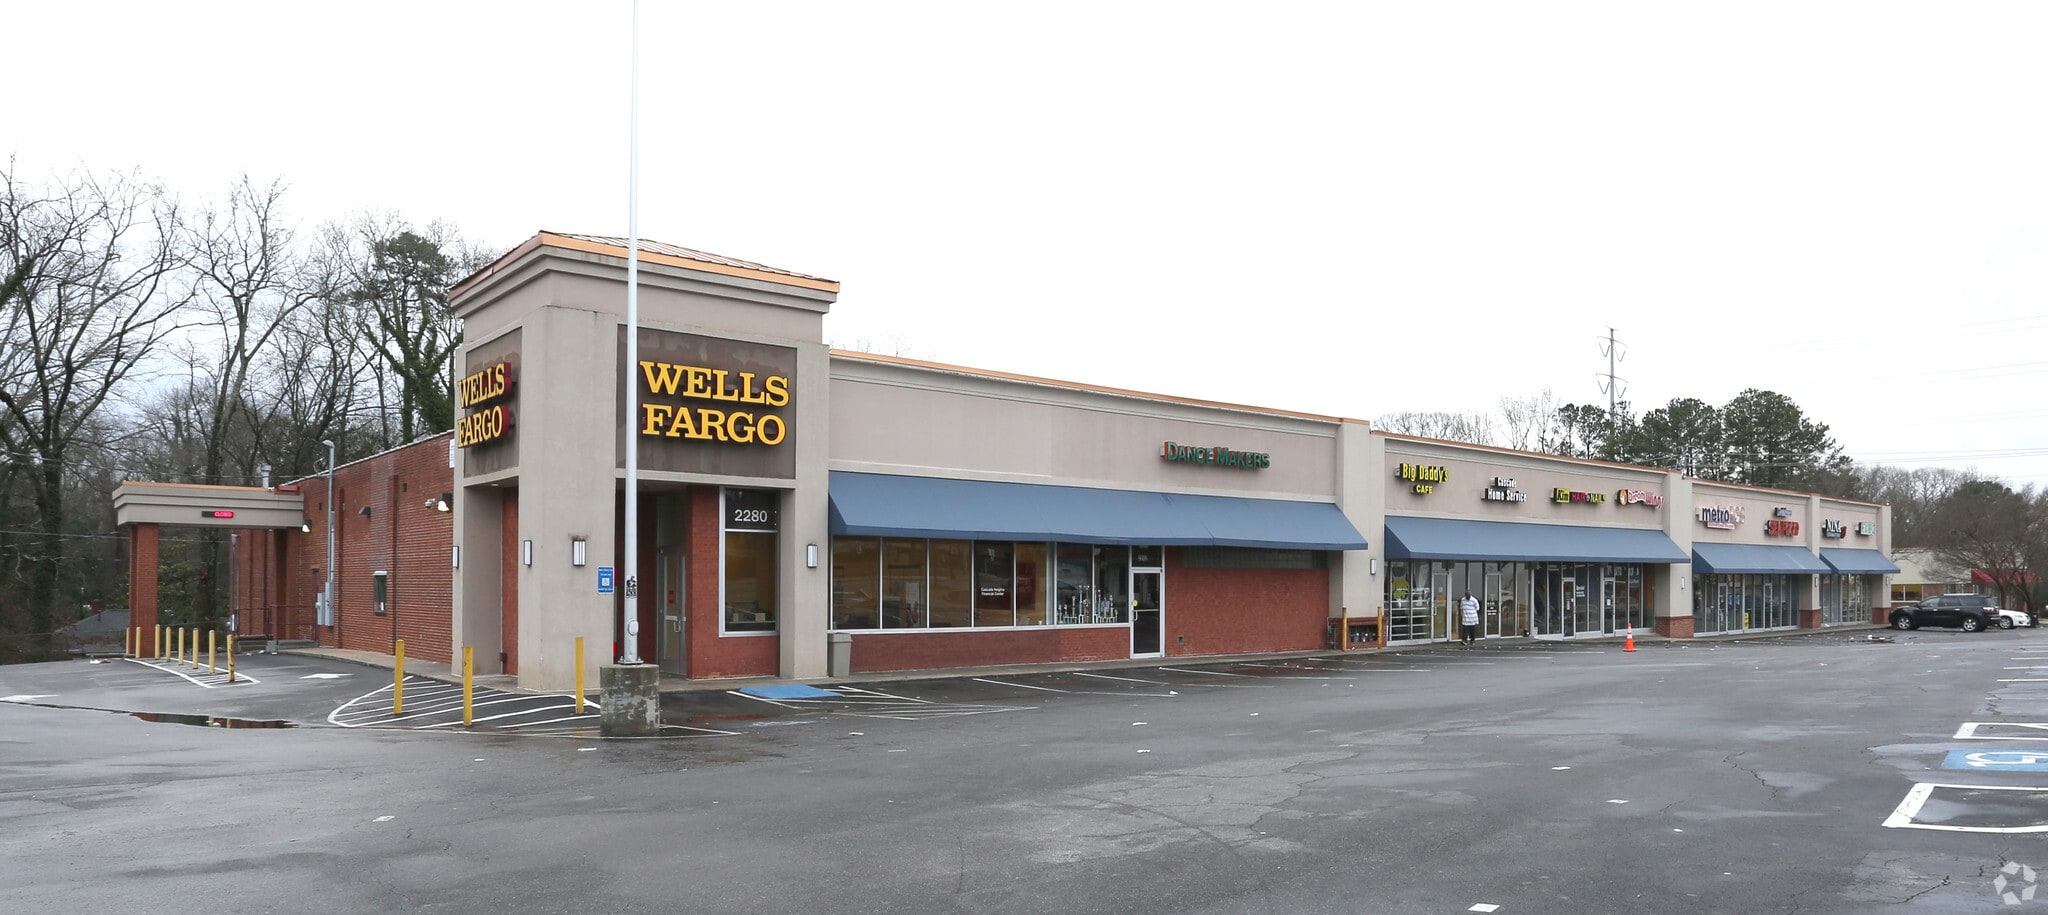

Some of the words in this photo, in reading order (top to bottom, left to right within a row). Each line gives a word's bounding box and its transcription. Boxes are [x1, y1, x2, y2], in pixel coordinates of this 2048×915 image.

[457, 362, 506, 408] WELLS
[639, 360, 790, 407] WELLS
[457, 405, 504, 448] FARGO
[642, 403, 787, 446] FARGO
[1166, 441, 1214, 464] DANCE
[1216, 447, 1271, 469] MAKERS
[1402, 463, 1416, 481] Big
[1418, 464, 1449, 483] Daddy's
[1416, 484, 1433, 494] CAFE
[1487, 488, 1504, 500] Home
[1506, 489, 1528, 502] Service
[734, 509, 768, 523] 2280
